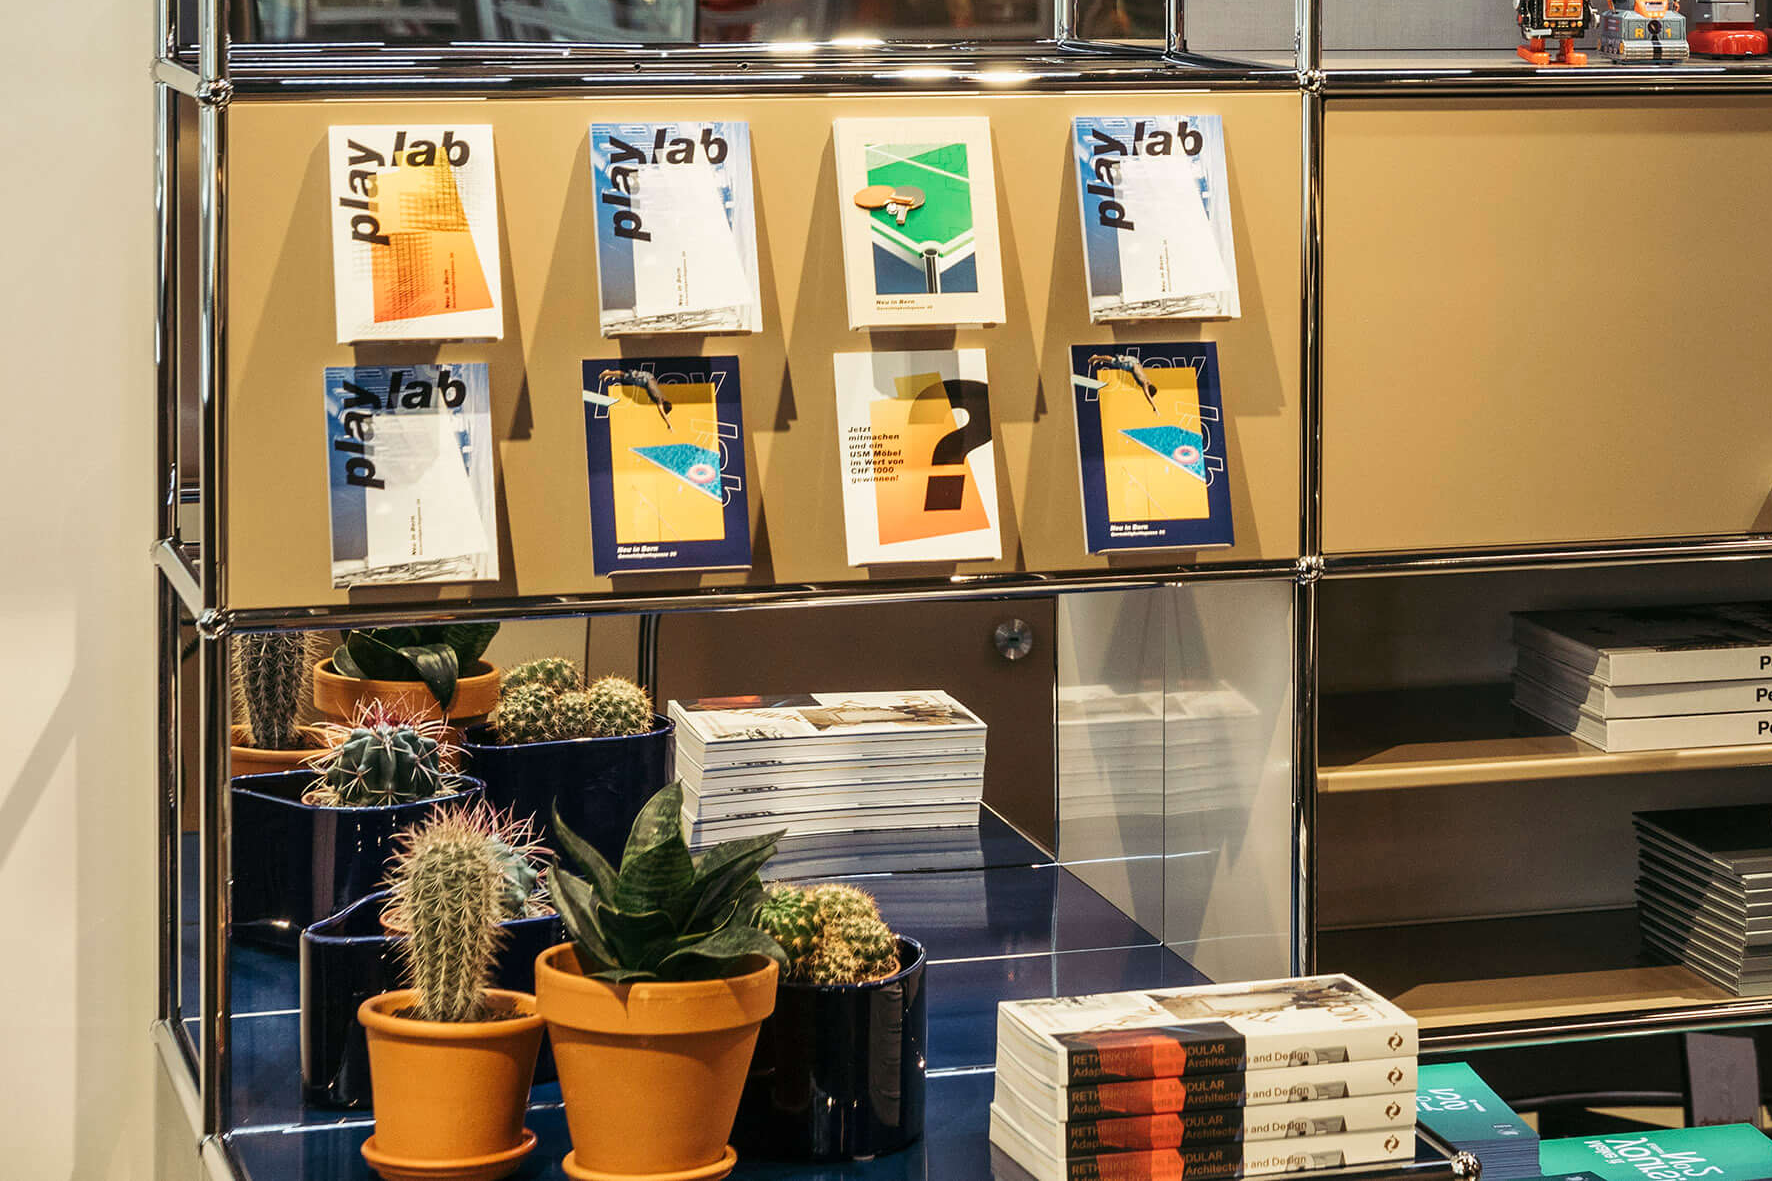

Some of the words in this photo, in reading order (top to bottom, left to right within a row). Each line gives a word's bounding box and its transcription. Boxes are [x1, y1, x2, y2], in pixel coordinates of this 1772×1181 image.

[1634, 27, 1645, 39] R
[1665, 28, 1672, 39] 1
[1133, 121, 1203, 156] lab
[391, 131, 470, 167] lab
[651, 128, 728, 164] lab
[1088, 129, 1134, 231] play
[339, 139, 391, 246] play
[602, 135, 651, 242] play
[386, 371, 466, 409] lab
[334, 380, 385, 490] play
[848, 433, 900, 441] mitmachen
[849, 442, 867, 450] und
[850, 450, 871, 458] USM
[873, 449, 902, 457] Möbel
[865, 458, 885, 466] Wert
[851, 467, 871, 475] CHF
[873, 466, 895, 474] 1000
[851, 474, 899, 484] gewinnen!
[1253, 1053, 1272, 1063] and
[1274, 1050, 1310, 1062] Design
[1252, 1089, 1272, 1099] and
[1274, 1086, 1310, 1099] Design
[1251, 1123, 1270, 1133] and
[1272, 1120, 1307, 1132] Design
[1251, 1158, 1270, 1168] and
[1272, 1155, 1307, 1167] Design
